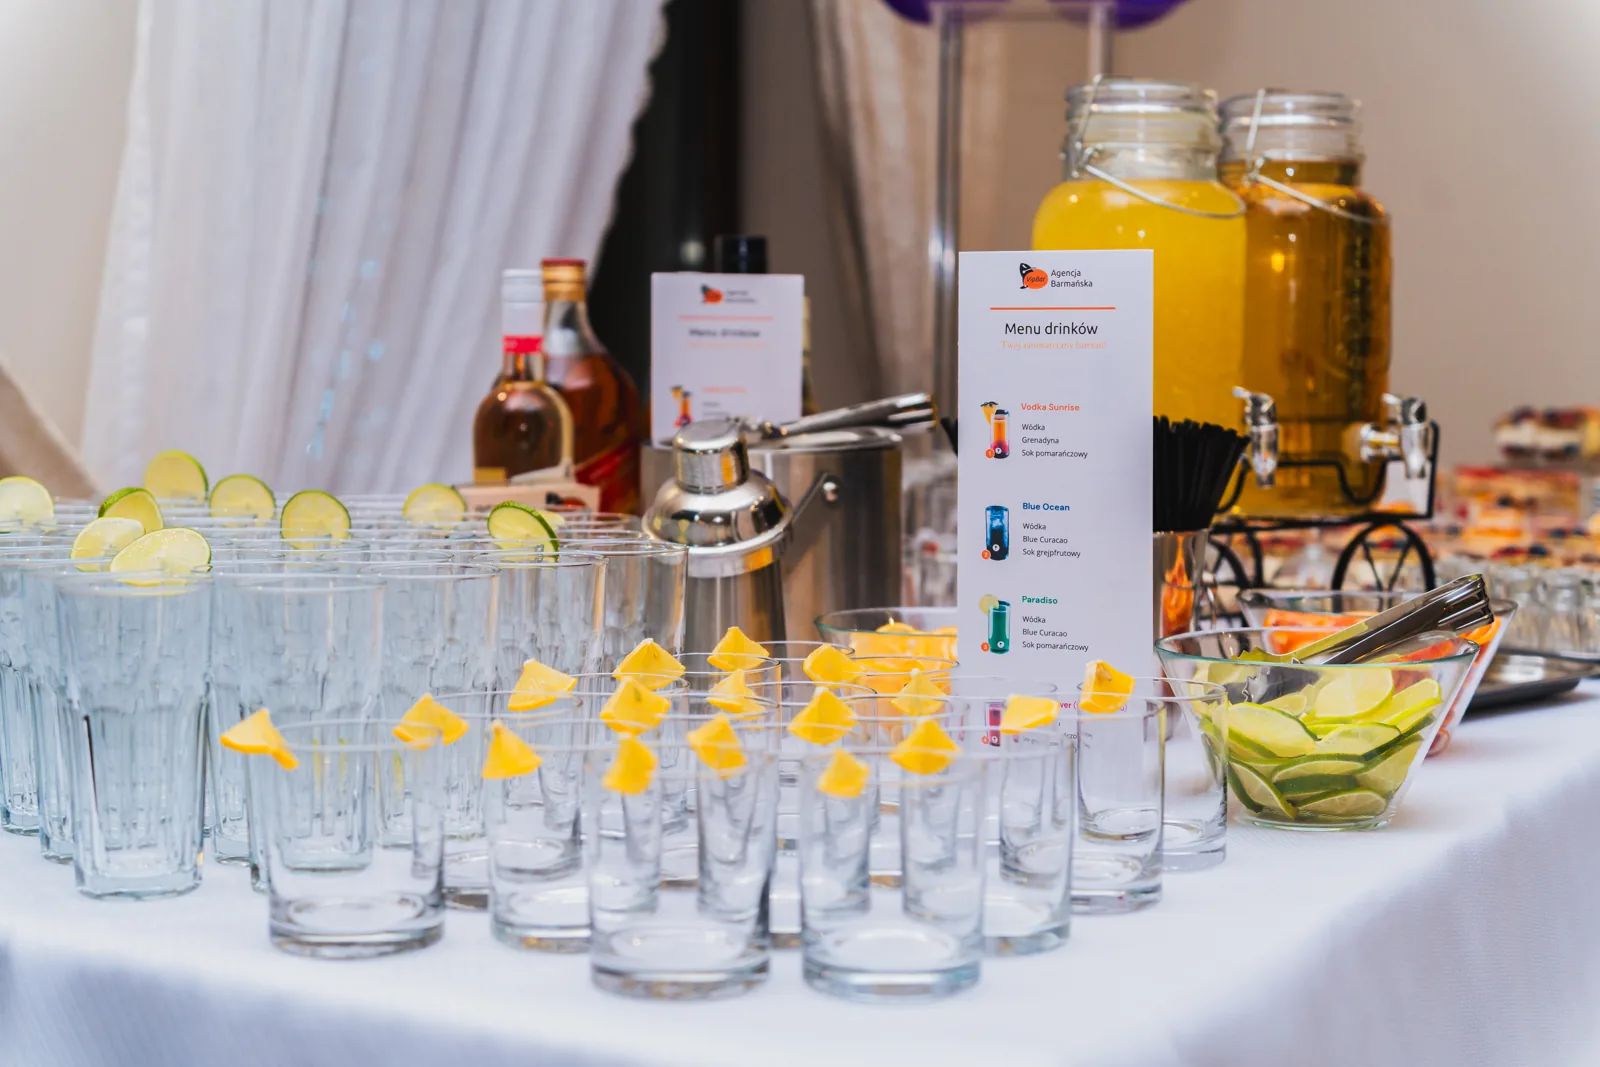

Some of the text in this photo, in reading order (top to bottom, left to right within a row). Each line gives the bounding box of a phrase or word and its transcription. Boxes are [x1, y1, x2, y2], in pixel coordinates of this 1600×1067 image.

[1050, 268, 1082, 279] Agencja
[1050, 279, 1093, 288] Barmańska
[1004, 321, 1099, 335] Menu drinków
[1020, 402, 1080, 412] Vodka Sunrise
[1021, 423, 1046, 431] Wódka
[1021, 436, 1060, 445] Grenadyna
[1021, 449, 1089, 460] Sok pomarańczowy
[1022, 502, 1071, 512] Blue Ocean
[1022, 522, 1047, 531] Wódka
[1022, 535, 1069, 545] Blue Curacao
[1022, 548, 1081, 559] Sok grejpfrutowy
[1021, 595, 1058, 605] Paradiso
[1022, 615, 1046, 624] Wódka
[1022, 628, 1068, 638] Blue Curacao
[1022, 640, 1090, 653] Sok pomarańczowy
